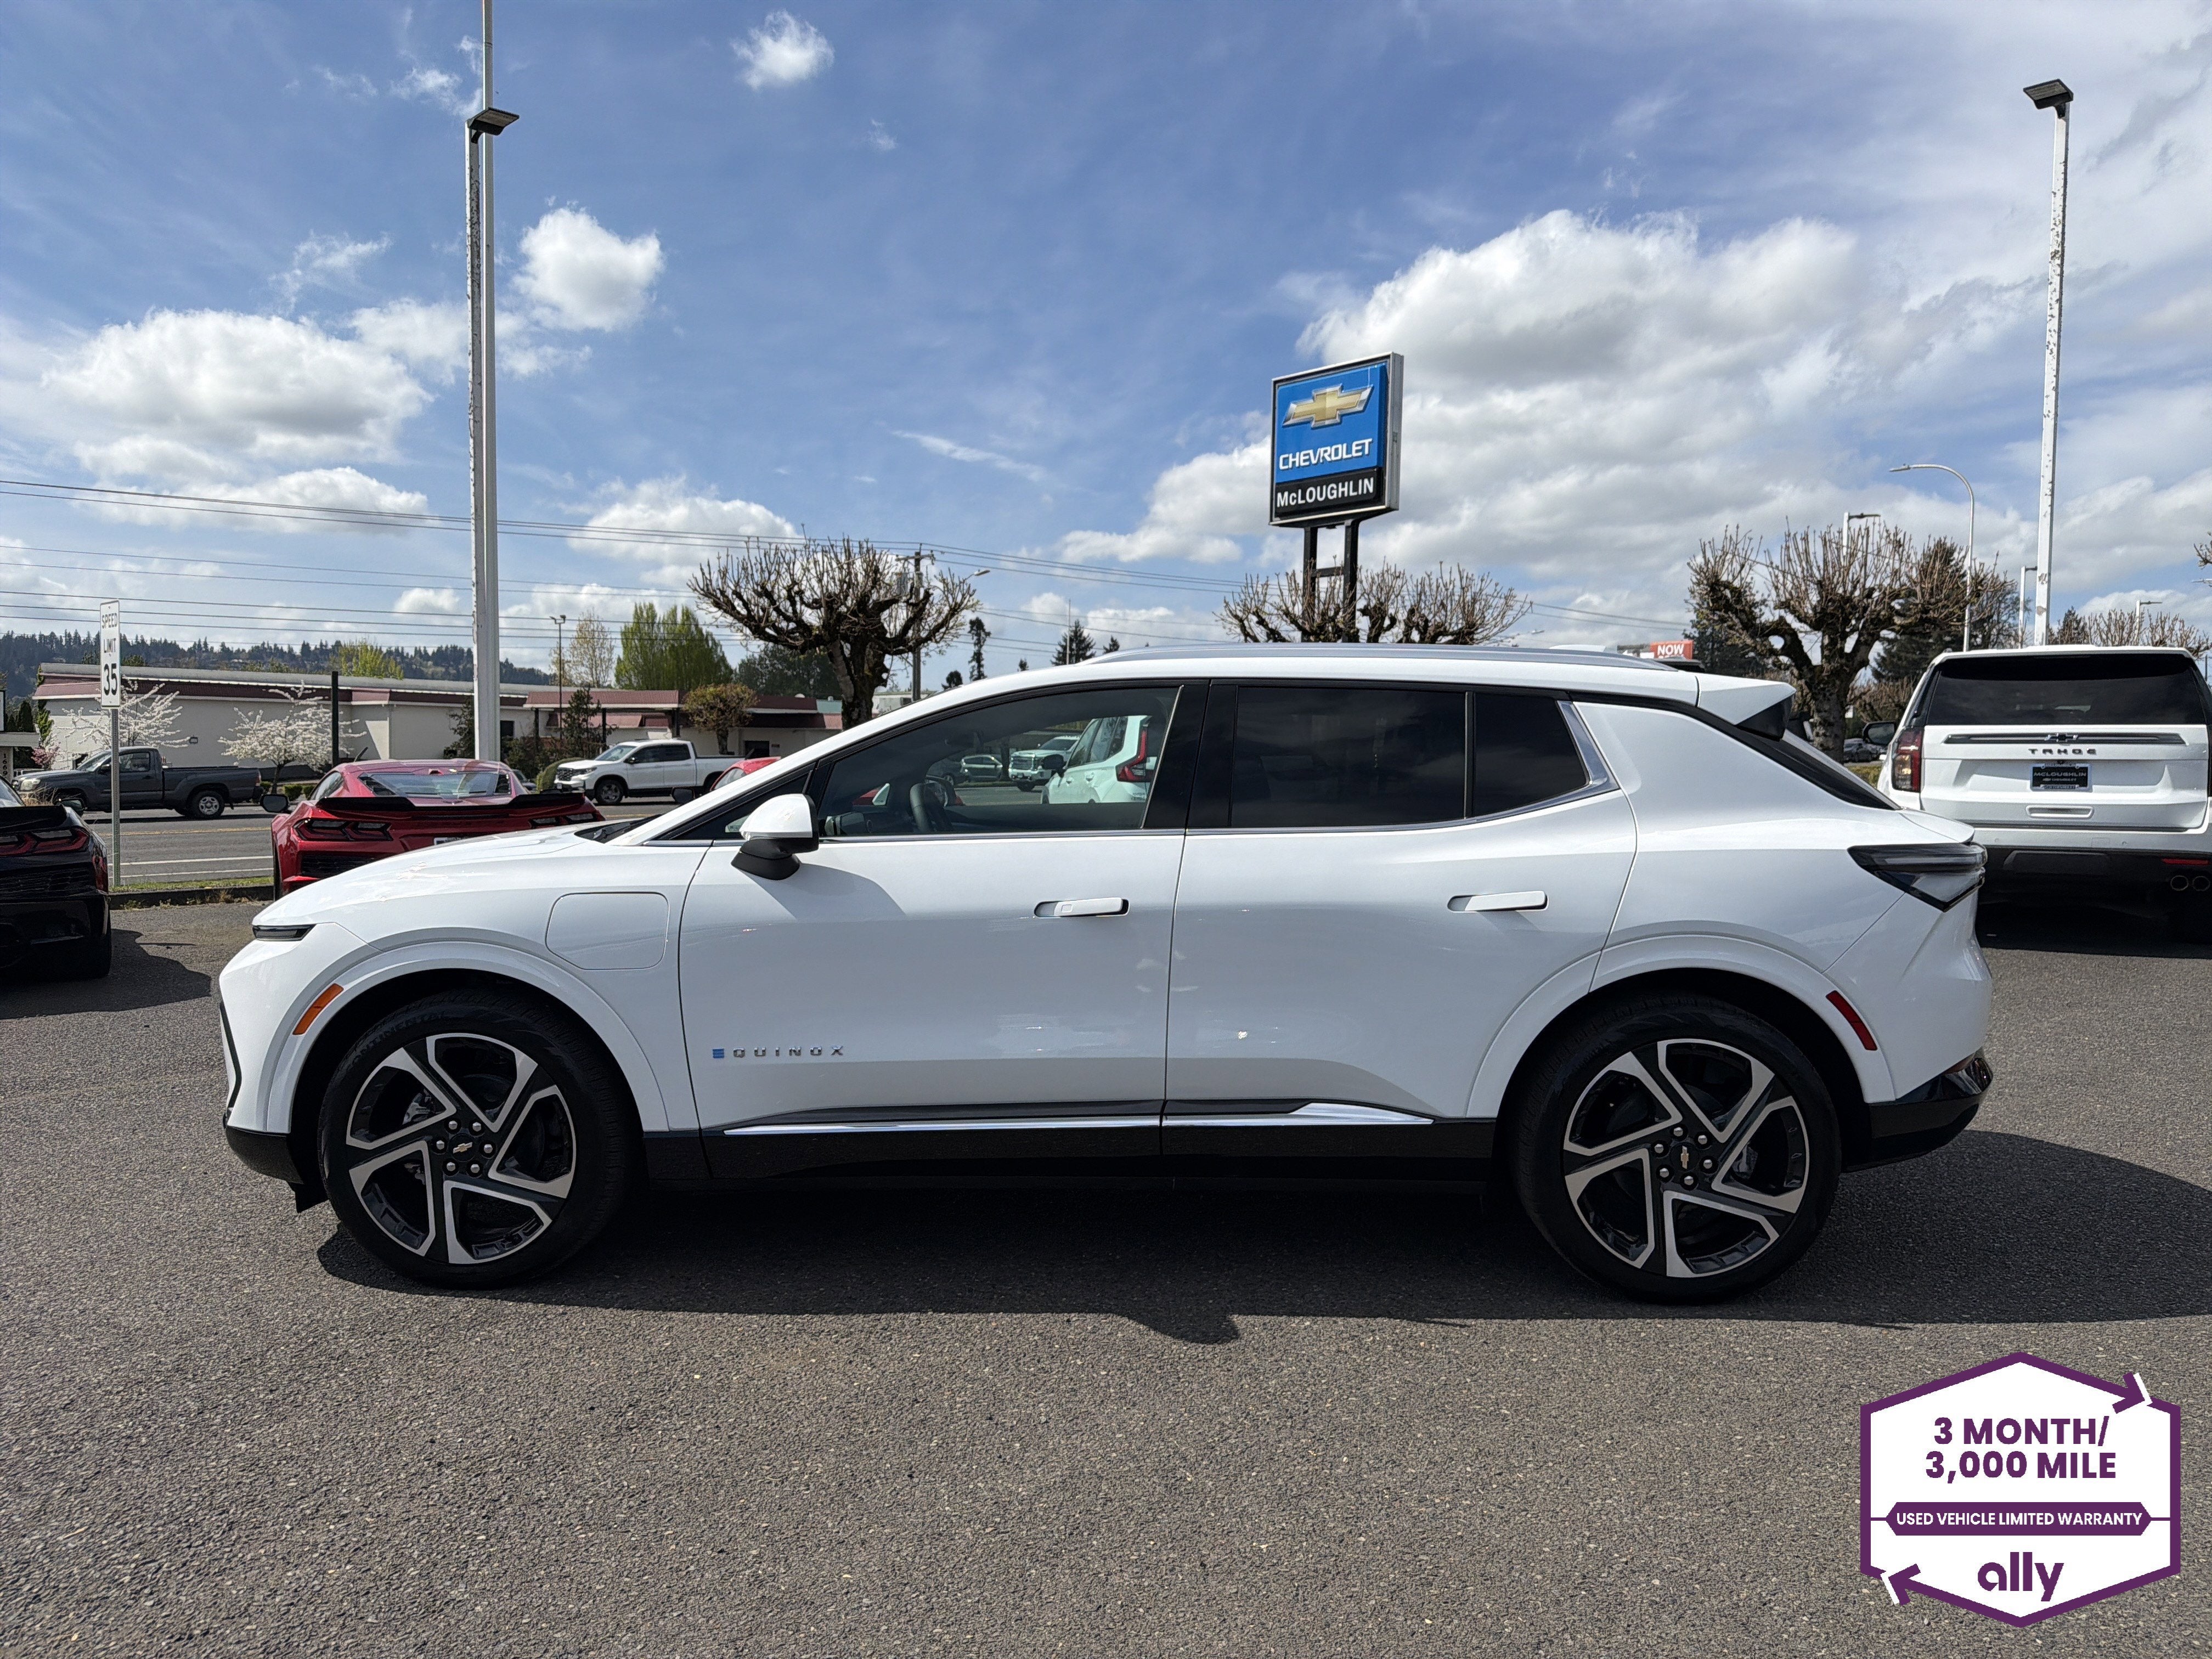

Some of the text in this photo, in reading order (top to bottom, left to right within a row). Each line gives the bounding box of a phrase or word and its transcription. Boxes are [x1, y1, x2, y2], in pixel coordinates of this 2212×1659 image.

[1279, 438, 1373, 470] CHEVROLET
[1277, 477, 1374, 507] McLOUGHLIN
[101, 612, 118, 629] SPEED
[103, 637, 116, 653] LIMIT
[1657, 644, 1684, 656] NOW
[104, 663, 117, 696] 35
